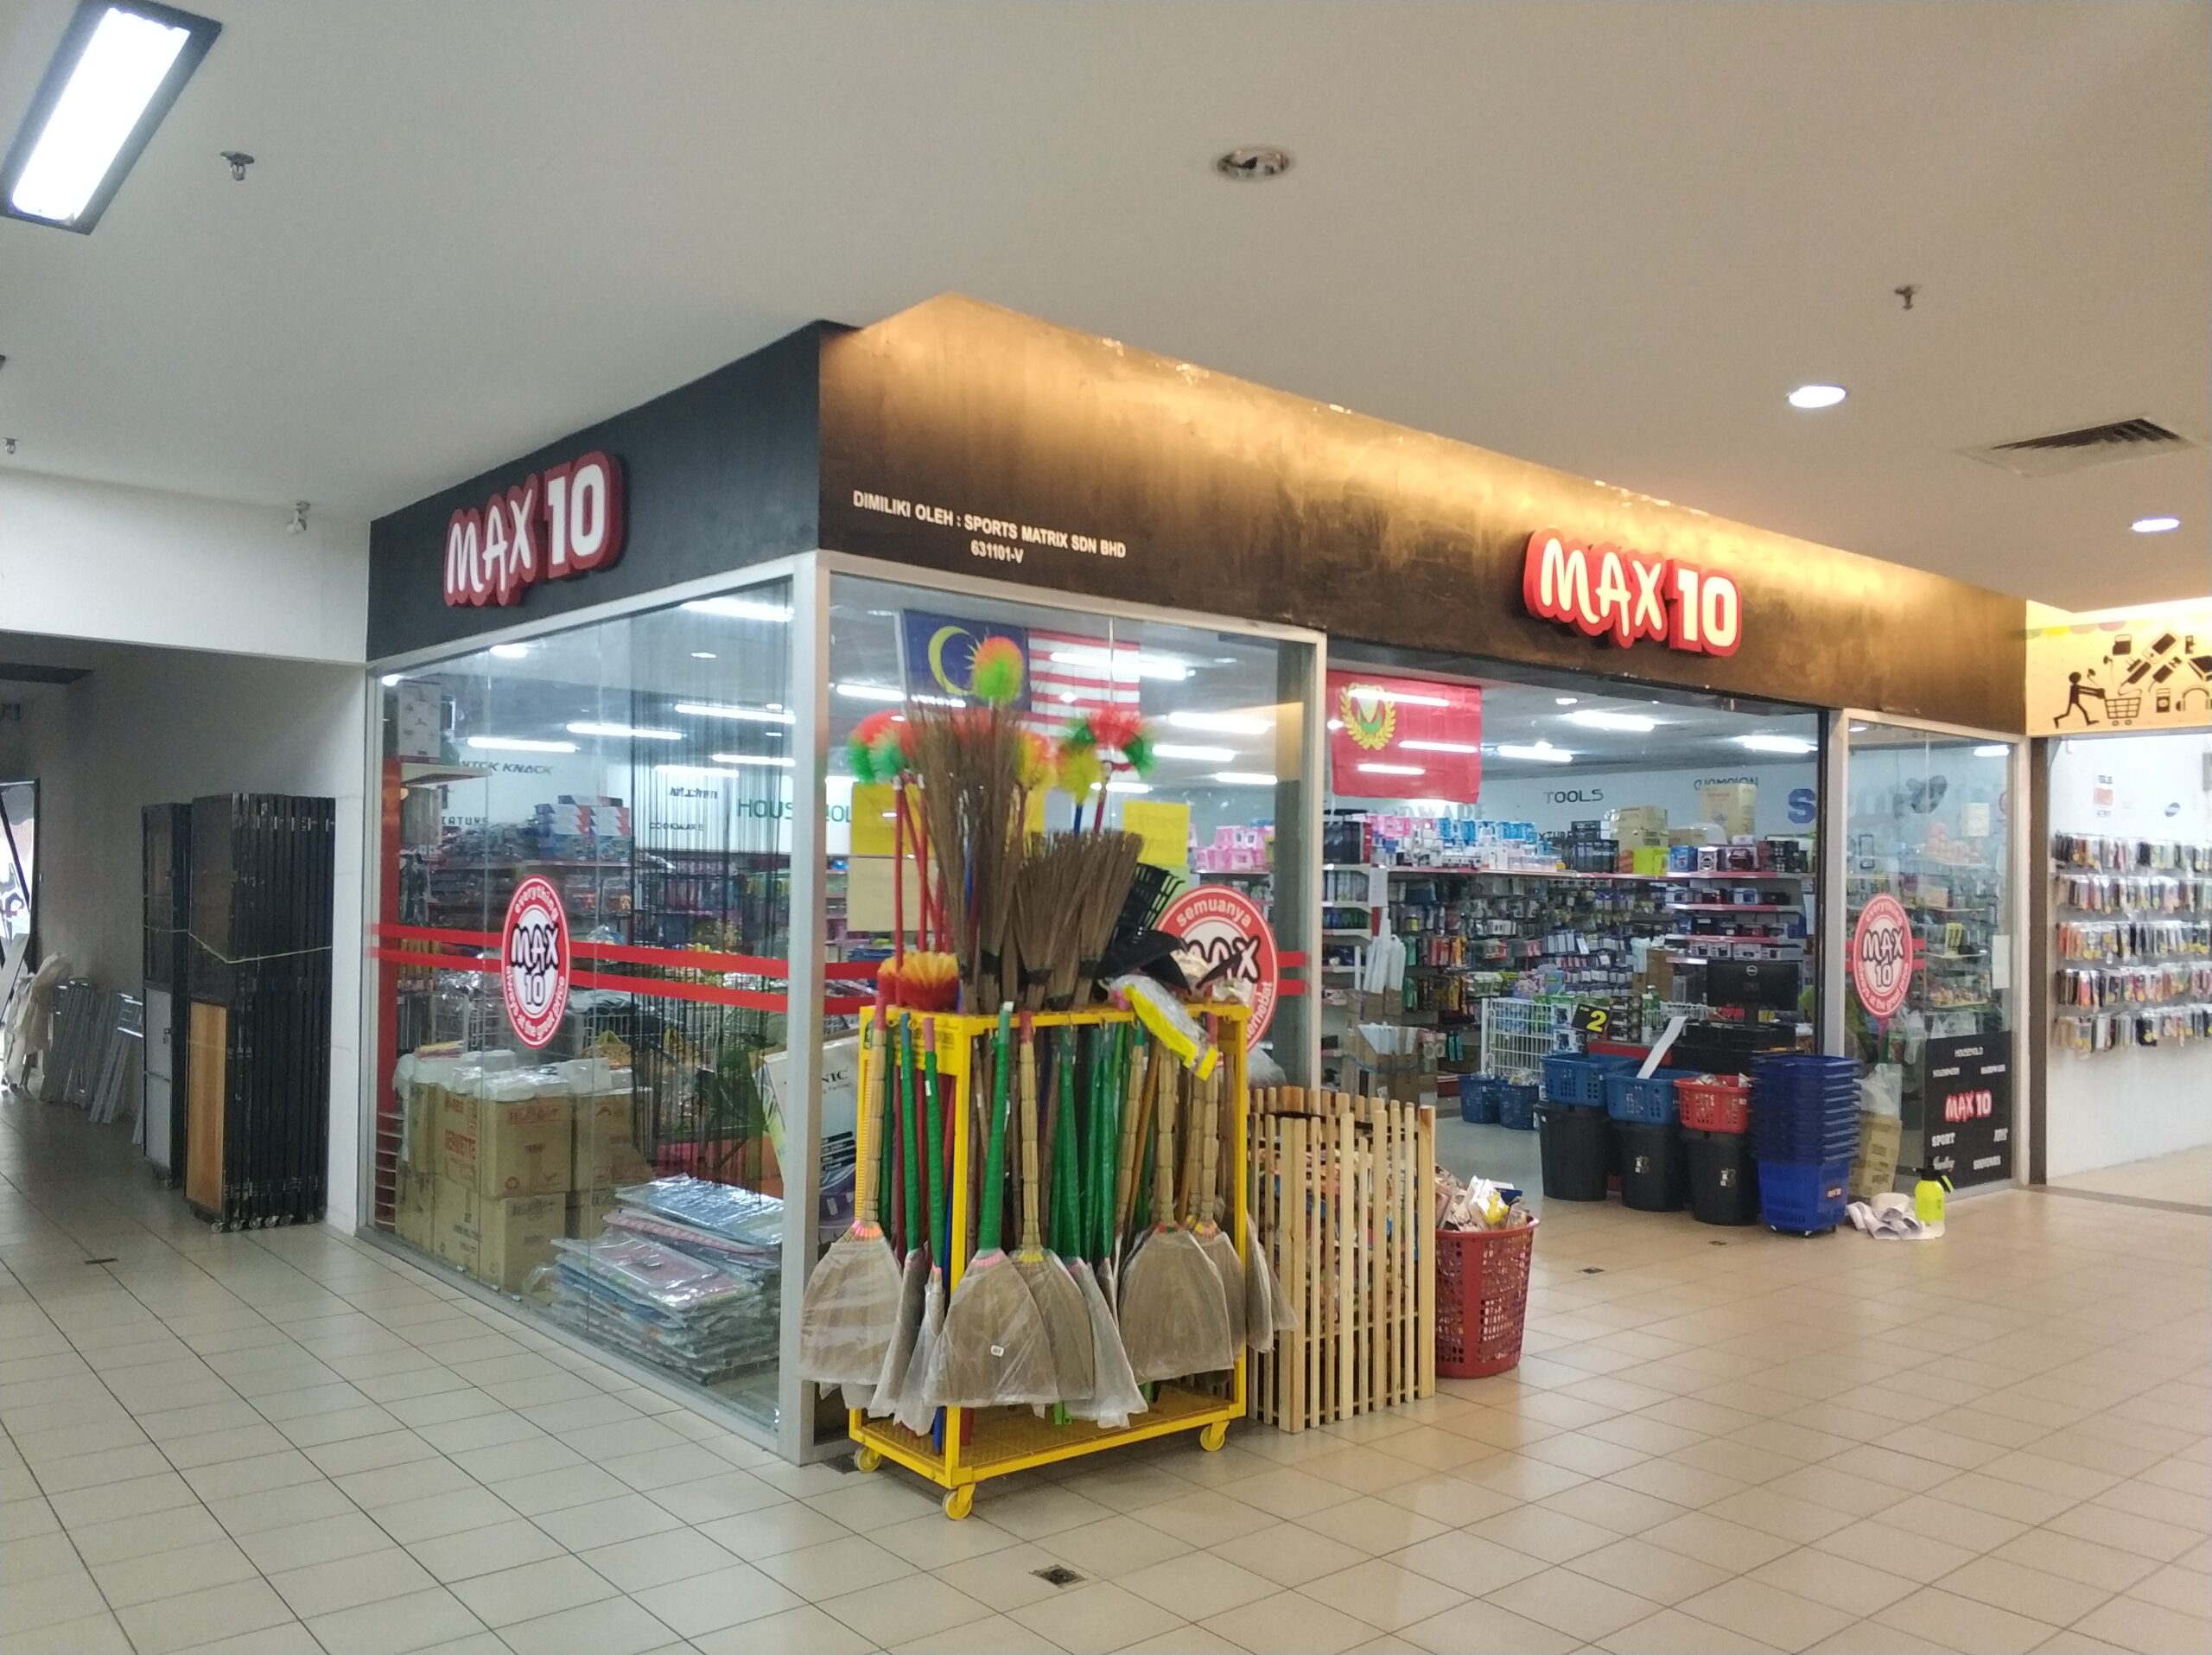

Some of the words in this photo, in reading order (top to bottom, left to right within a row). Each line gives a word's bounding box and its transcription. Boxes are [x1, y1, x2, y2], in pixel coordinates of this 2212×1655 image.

[446, 486, 533, 595] MAX
[546, 462, 607, 566] 10
[853, 490, 912, 517] DIMILIKI
[914, 504, 954, 526] OLEH
[963, 514, 1019, 539] SPORTS
[1021, 527, 1069, 549] MATRIX
[1071, 536, 1097, 553] SDN
[1100, 540, 1127, 557] BHD
[970, 541, 1025, 563] 631101-V
[1539, 537, 1663, 638] MAX
[1676, 567, 1738, 648] 10
[1543, 788, 1604, 804] TOOLS
[1175, 899, 1253, 927] semuanya
[511, 922, 559, 975] MAX
[1861, 927, 1904, 964] MAX
[524, 972, 546, 1006] 10
[1874, 963, 1893, 988] 10
[1586, 1009, 1607, 1033] 2
[1945, 1093, 1974, 1122] MAX
[1976, 1092, 1993, 1117] 10
